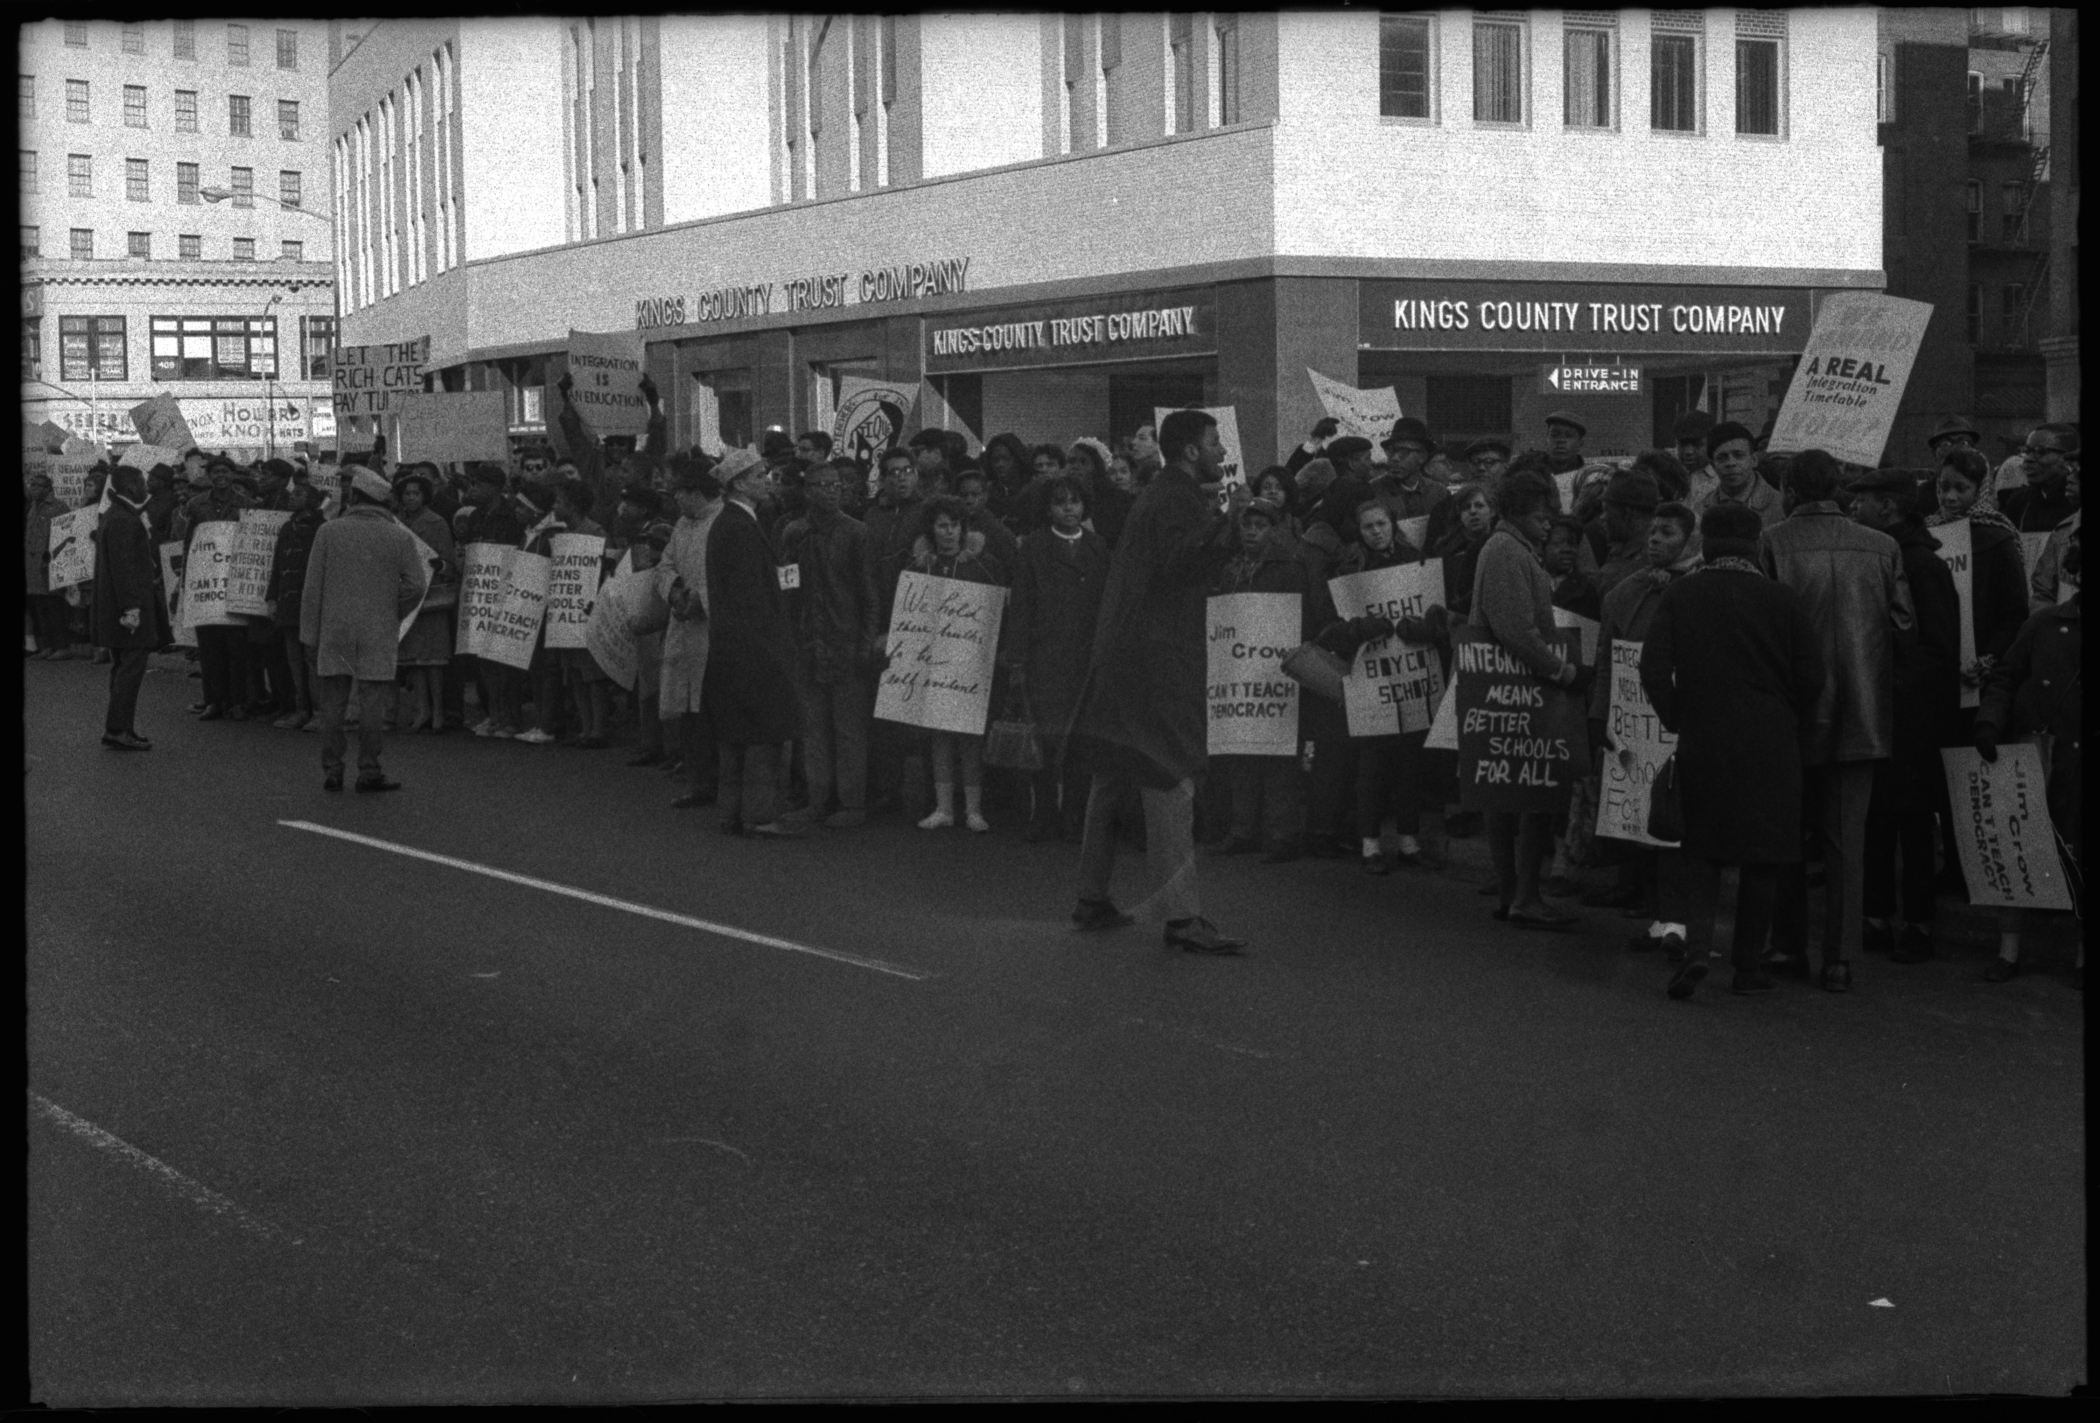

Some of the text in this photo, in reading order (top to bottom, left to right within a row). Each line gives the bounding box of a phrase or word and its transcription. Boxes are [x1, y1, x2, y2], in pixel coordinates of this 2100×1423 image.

[637, 256, 970, 330] KINGS COUNTY TRUST COMPANY
[1394, 300, 1785, 336] KINGS COUNTY TRUST COMPANY
[933, 305, 1194, 356] KINGS COUNTY TRUST COMPANY
[334, 342, 418, 366] LET THE
[570, 354, 638, 372] INTEGRATION
[336, 364, 424, 390] RICH CATS
[596, 374, 609, 386] IS
[1562, 368, 1640, 380] DRIVE-IN
[1806, 356, 1891, 385] A REAL
[1562, 380, 1639, 391] ENTRANCE
[1806, 376, 1878, 395] Integration
[334, 392, 359, 412] PAY
[584, 391, 644, 407] EDUCATION
[1803, 390, 1868, 407] Timetable
[194, 590, 227, 602] DEMOC
[1210, 624, 1236, 642] Jim
[1243, 682, 1295, 698] TEACH
[1486, 685, 1544, 707] MEANS
[1210, 702, 1288, 720] DEMOCRACY
[1463, 708, 1530, 736] BETTER
[1490, 737, 1570, 760] SCHOOLS
[1475, 759, 1558, 787] FOR ALL
[1968, 771, 2000, 891] DEMOCRACY
[2009, 759, 2034, 897] Jim Crow
[1988, 834, 2014, 900] TEACH
